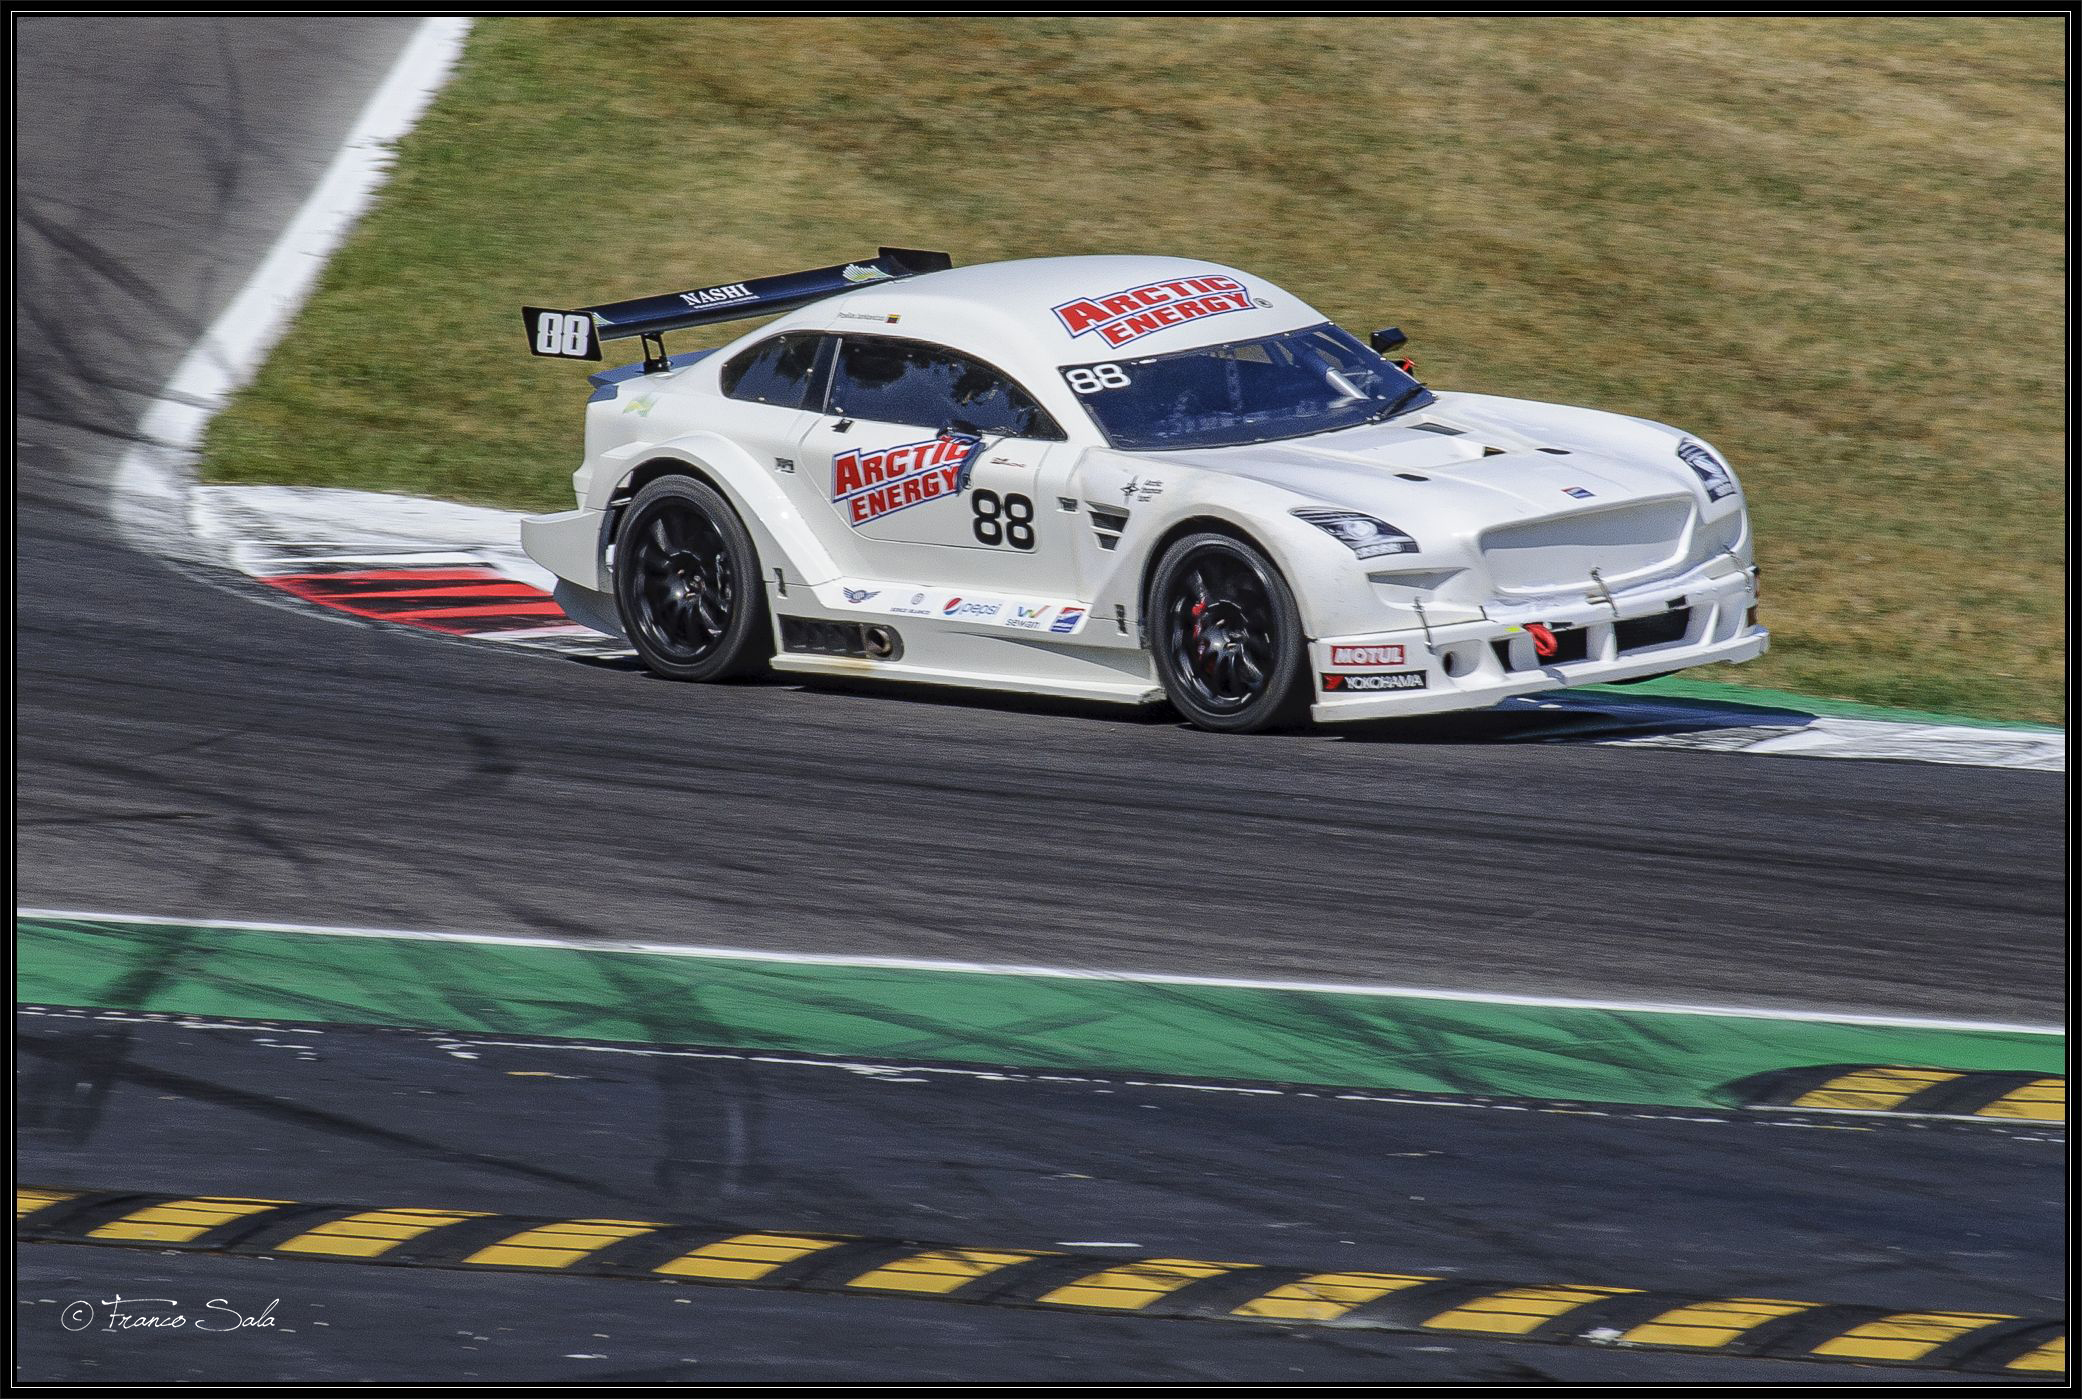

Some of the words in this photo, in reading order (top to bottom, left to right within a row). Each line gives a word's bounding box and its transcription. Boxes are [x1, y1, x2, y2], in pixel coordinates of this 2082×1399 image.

[680, 283, 753, 306] NASHI
[1057, 275, 1237, 333] ARCTIC
[536, 312, 590, 357] 88
[1100, 292, 1248, 345] ENERGY
[1065, 363, 1131, 394] 88
[836, 435, 970, 496] ARCTIC
[851, 466, 960, 522] ENERGY
[971, 488, 1035, 550] 88
[961, 601, 1002, 619] pepsi
[1334, 647, 1403, 664] MOTUL
[1344, 674, 1424, 690] YOKOHAMA
